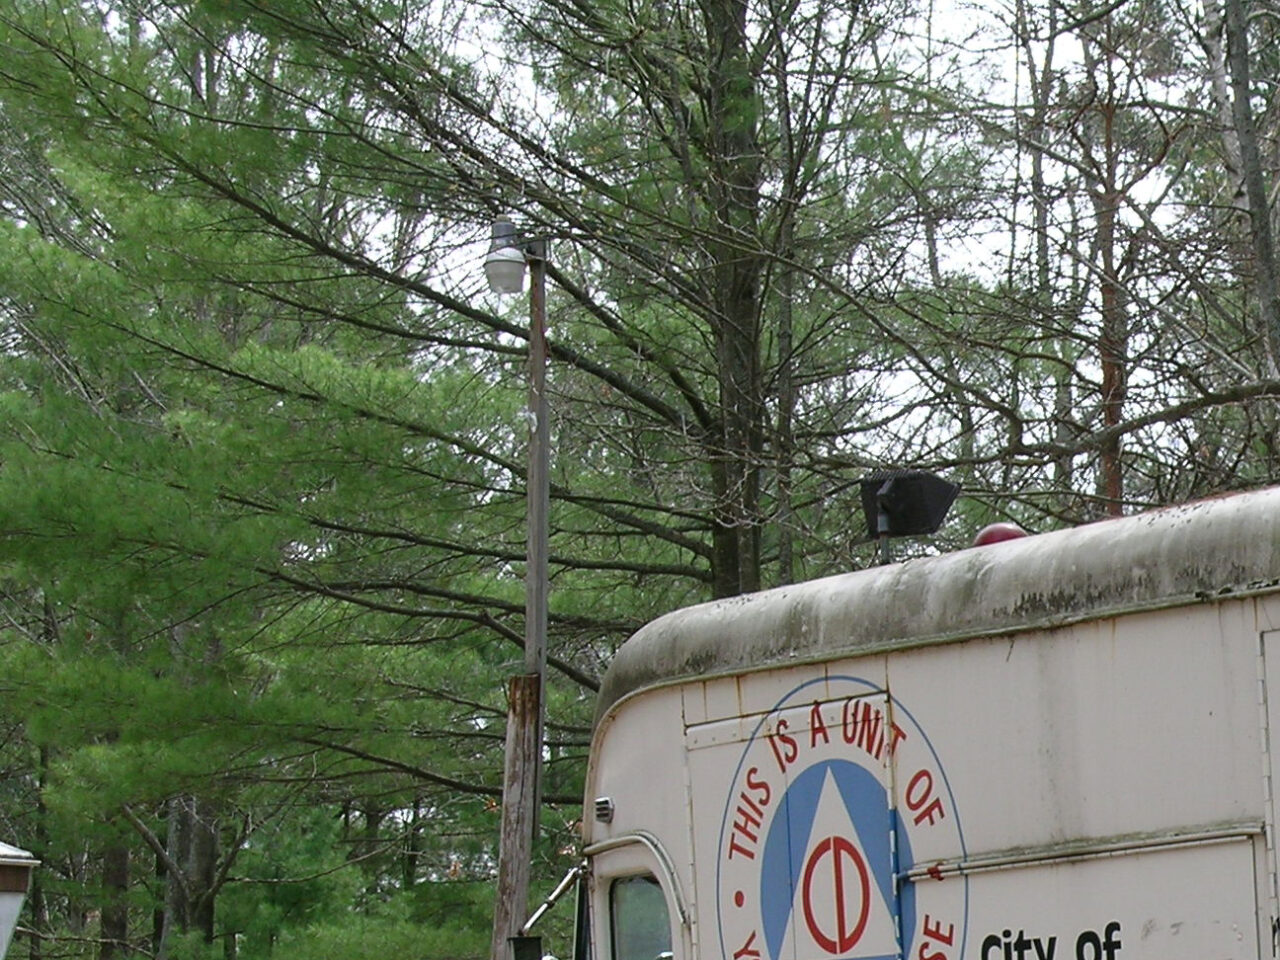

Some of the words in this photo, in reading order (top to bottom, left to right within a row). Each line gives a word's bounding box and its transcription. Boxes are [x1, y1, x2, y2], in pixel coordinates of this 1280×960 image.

[729, 767, 771, 861] THIS
[768, 719, 798, 773] IS
[810, 699, 830, 748] A
[842, 697, 907, 761] UNIT
[905, 769, 945, 827] OF
